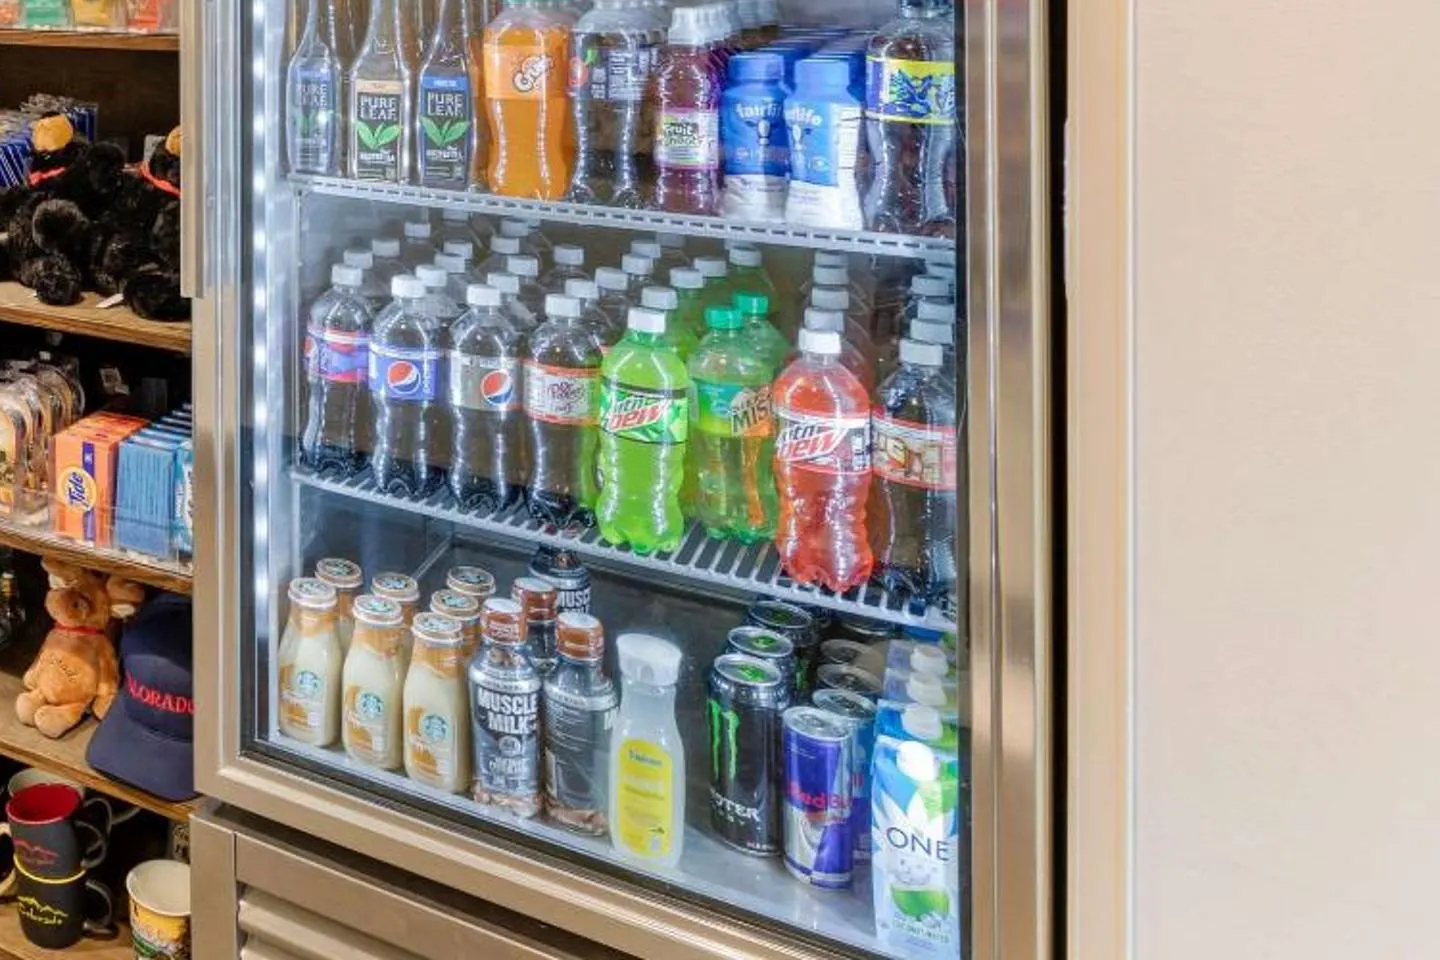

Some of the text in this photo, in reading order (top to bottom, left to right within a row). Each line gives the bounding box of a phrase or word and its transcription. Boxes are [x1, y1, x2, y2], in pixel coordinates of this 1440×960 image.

[360, 95, 397, 108] PURE
[427, 92, 463, 105] PURE
[360, 107, 398, 120] LEAF
[427, 104, 464, 117] LEAF
[67, 471, 91, 507] Tide
[477, 687, 538, 715] MUSCLE
[487, 711, 532, 735] MILK
[886, 826, 950, 861] ONE
